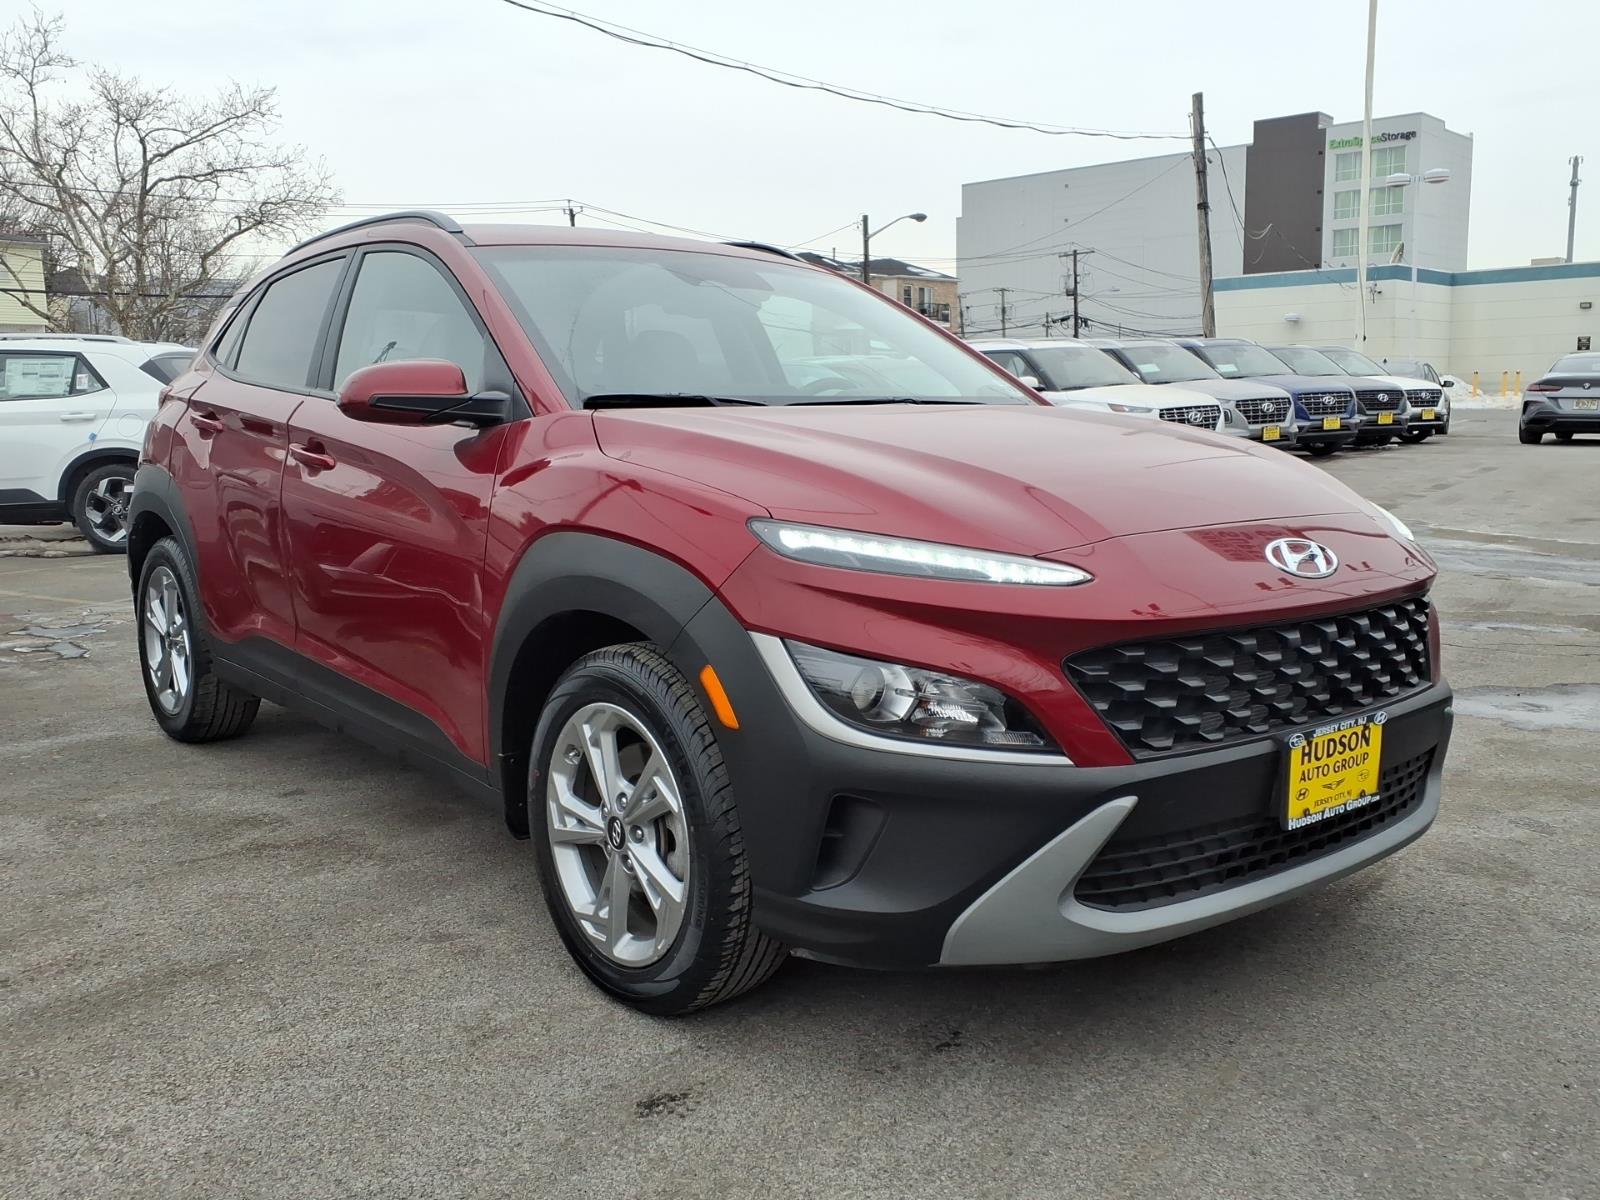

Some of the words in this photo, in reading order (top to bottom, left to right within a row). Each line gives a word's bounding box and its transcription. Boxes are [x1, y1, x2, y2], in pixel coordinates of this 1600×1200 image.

[1314, 723, 1340, 737] JERSEY
[1357, 716, 1367, 726] NJ
[1301, 726, 1370, 765] HUDSON
[1299, 763, 1330, 783] AUTO
[1333, 752, 1369, 773] GROUP
[1314, 796, 1333, 808] JERSEY
[1288, 812, 1322, 830] HUDSON
[1323, 805, 1345, 819] AUTO
